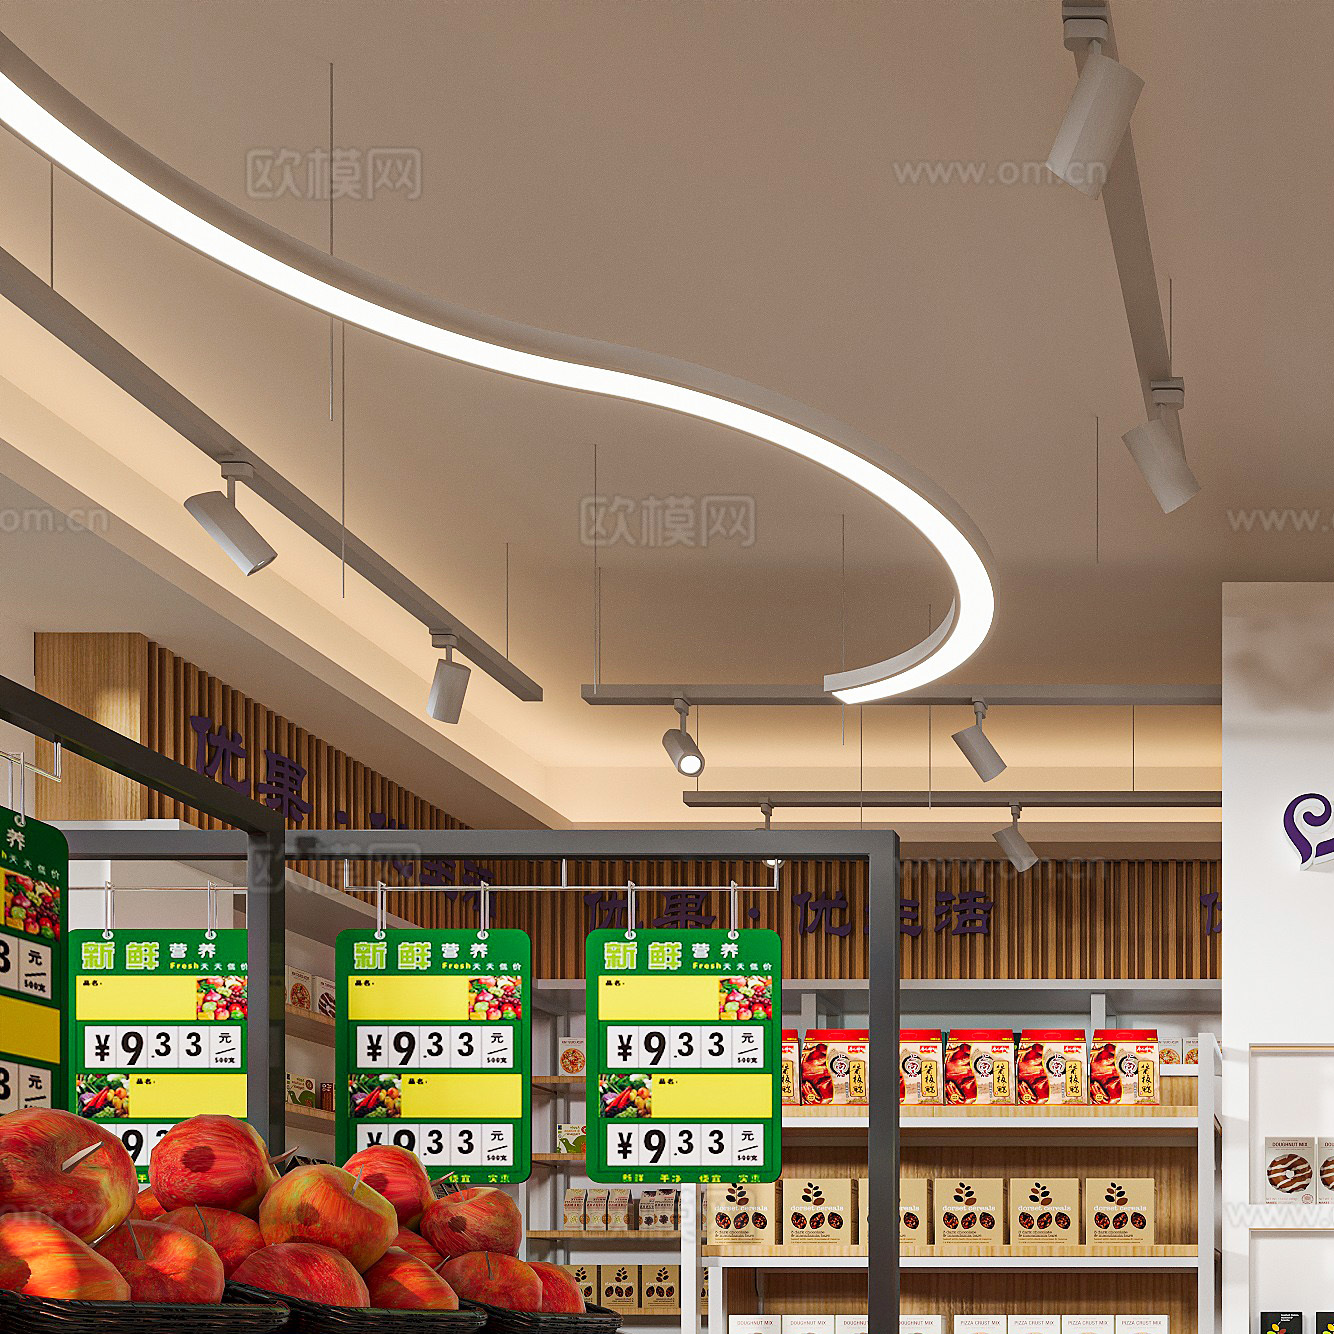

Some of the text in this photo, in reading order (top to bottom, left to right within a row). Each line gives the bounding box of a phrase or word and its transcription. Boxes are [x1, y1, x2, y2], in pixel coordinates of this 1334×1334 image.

[82, 941, 216, 970] 新鲜 营养
[354, 941, 488, 970] 新鲜 营养
[604, 941, 738, 970] 新鲜 营养
